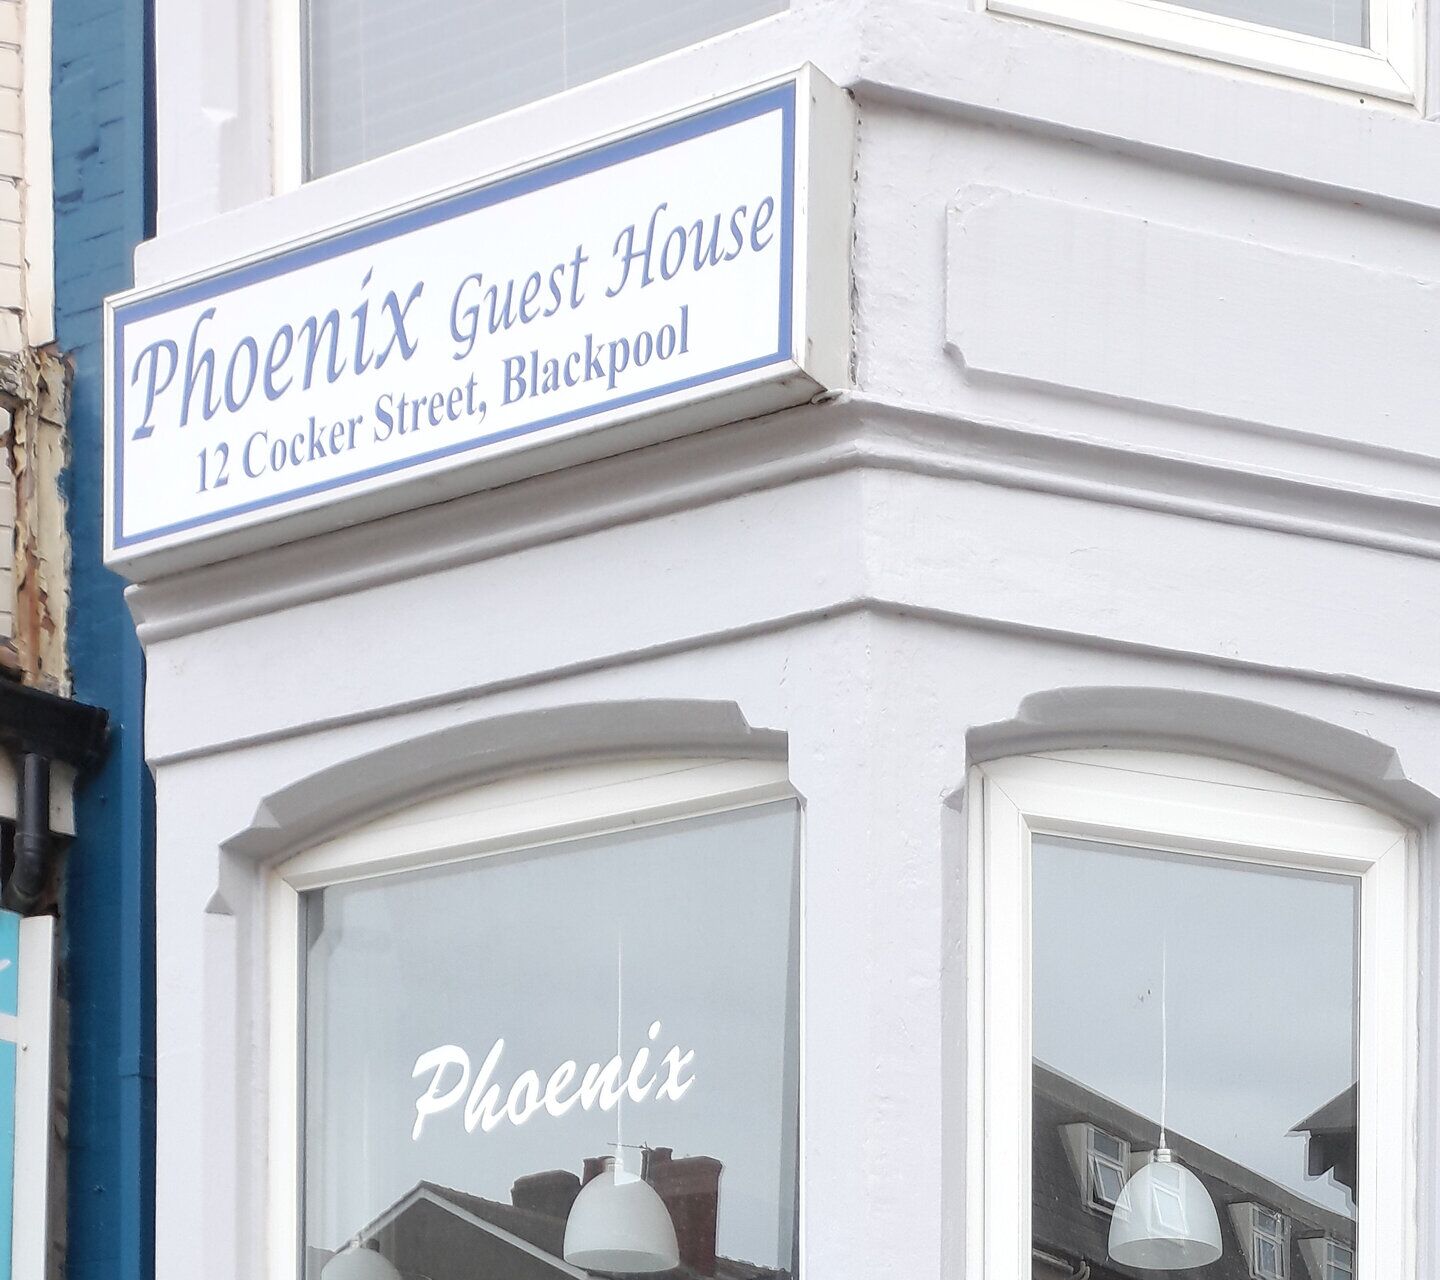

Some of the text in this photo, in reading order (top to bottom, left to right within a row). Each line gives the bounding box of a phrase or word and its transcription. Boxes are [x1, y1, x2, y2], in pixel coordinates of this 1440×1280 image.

[130, 193, 776, 441] Phoenix Guest House
[195, 305, 690, 494] 12 Cocker Street, Blackpool
[411, 1020, 697, 1141] Phoenix
